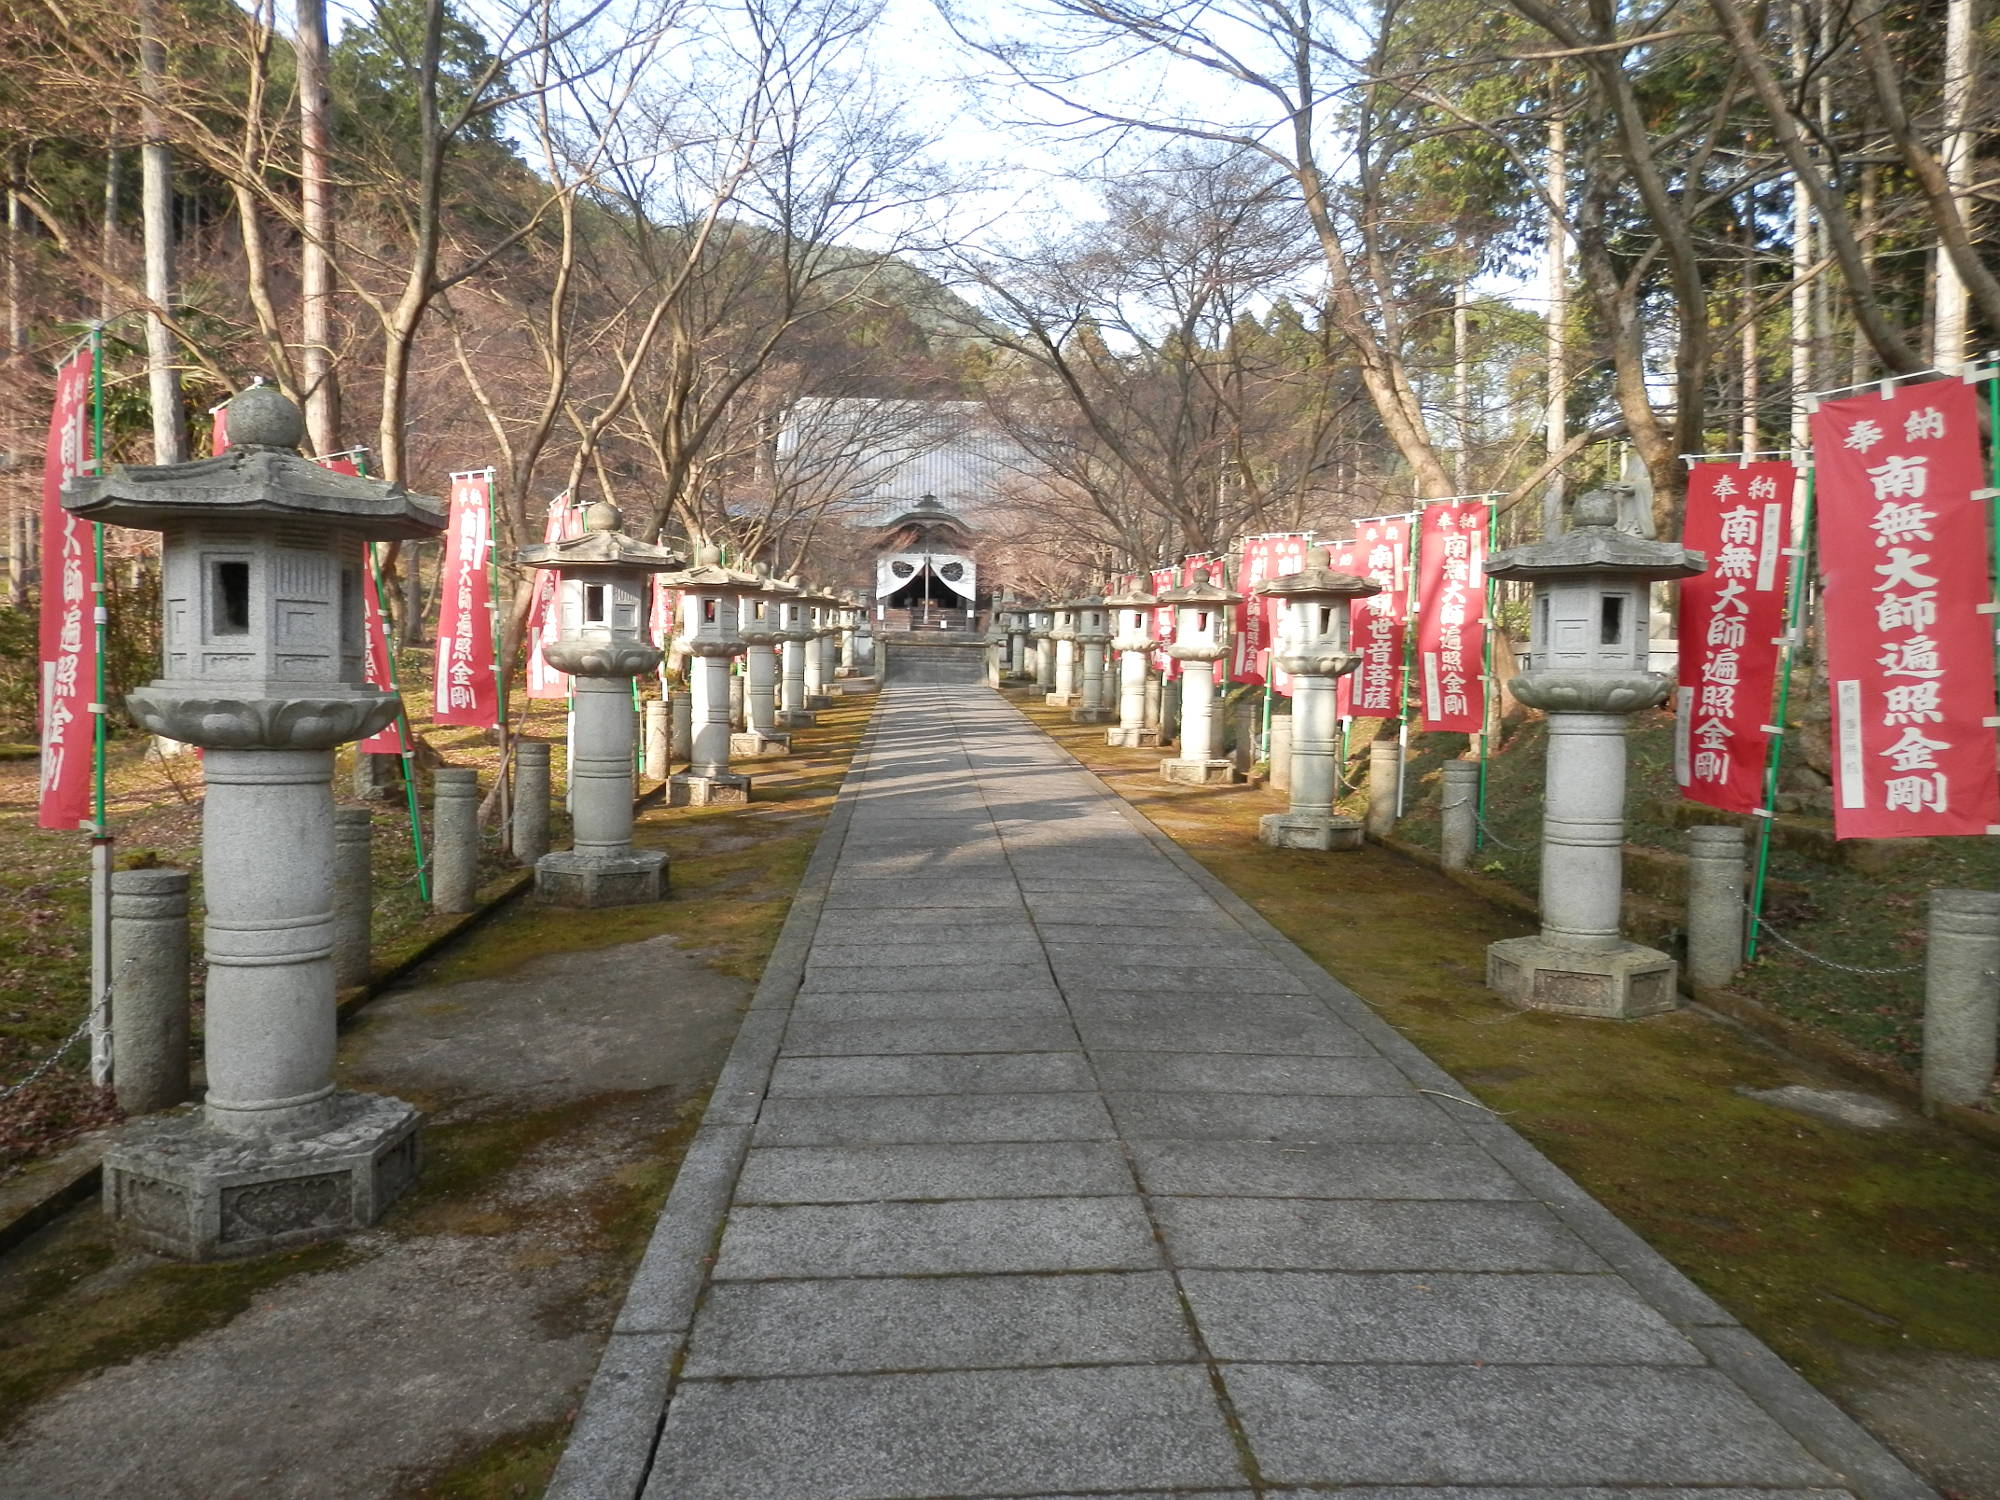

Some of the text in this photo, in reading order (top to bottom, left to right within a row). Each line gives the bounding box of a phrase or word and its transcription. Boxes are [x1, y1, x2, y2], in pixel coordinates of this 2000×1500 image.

[1712, 474, 1777, 502] 奉納
[1843, 406, 1946, 454] 奉納
[1436, 511, 1477, 531] 奉納
[1439, 531, 1469, 716] 南無大師遍照金剛
[1694, 504, 1759, 785] 南無大師遍照金剛
[1866, 455, 1951, 813] 南無大師遍照金剛
